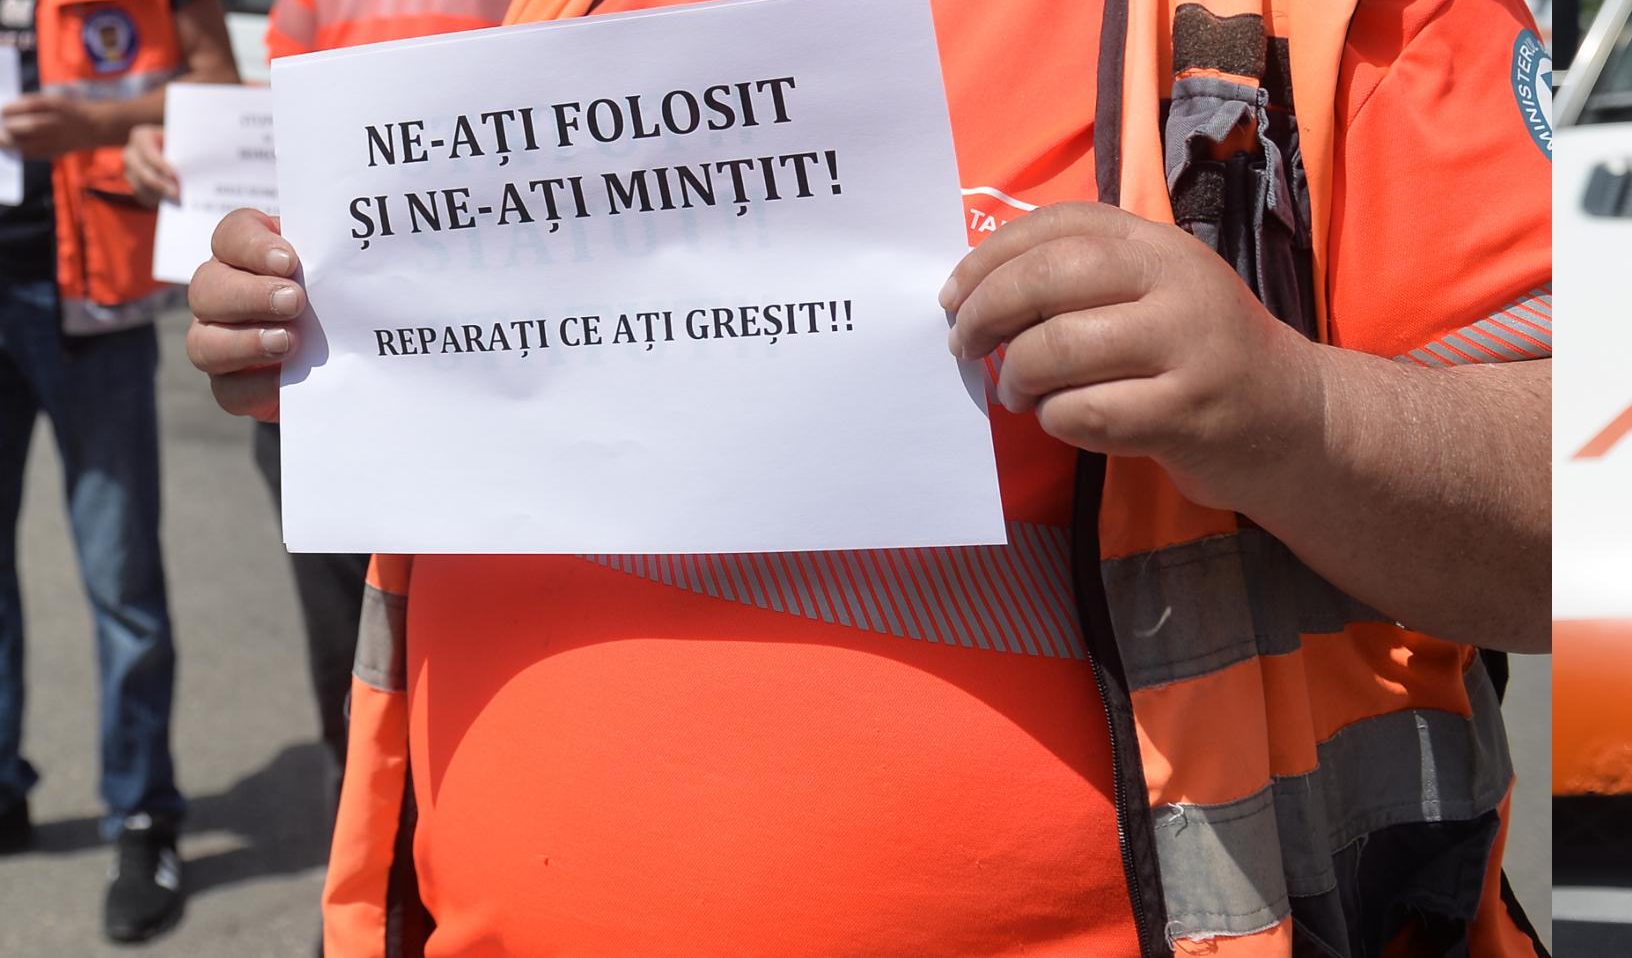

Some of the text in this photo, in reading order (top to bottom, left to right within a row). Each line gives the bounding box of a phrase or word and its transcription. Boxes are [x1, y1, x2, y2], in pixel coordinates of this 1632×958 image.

[366, 76, 796, 167] NE-AȚI FOLOSIT
[349, 150, 842, 251] ȘI NE-AȚI MINȚIT!
[374, 300, 853, 359] REPARAȚI CE AȚI GREȘIT!!
